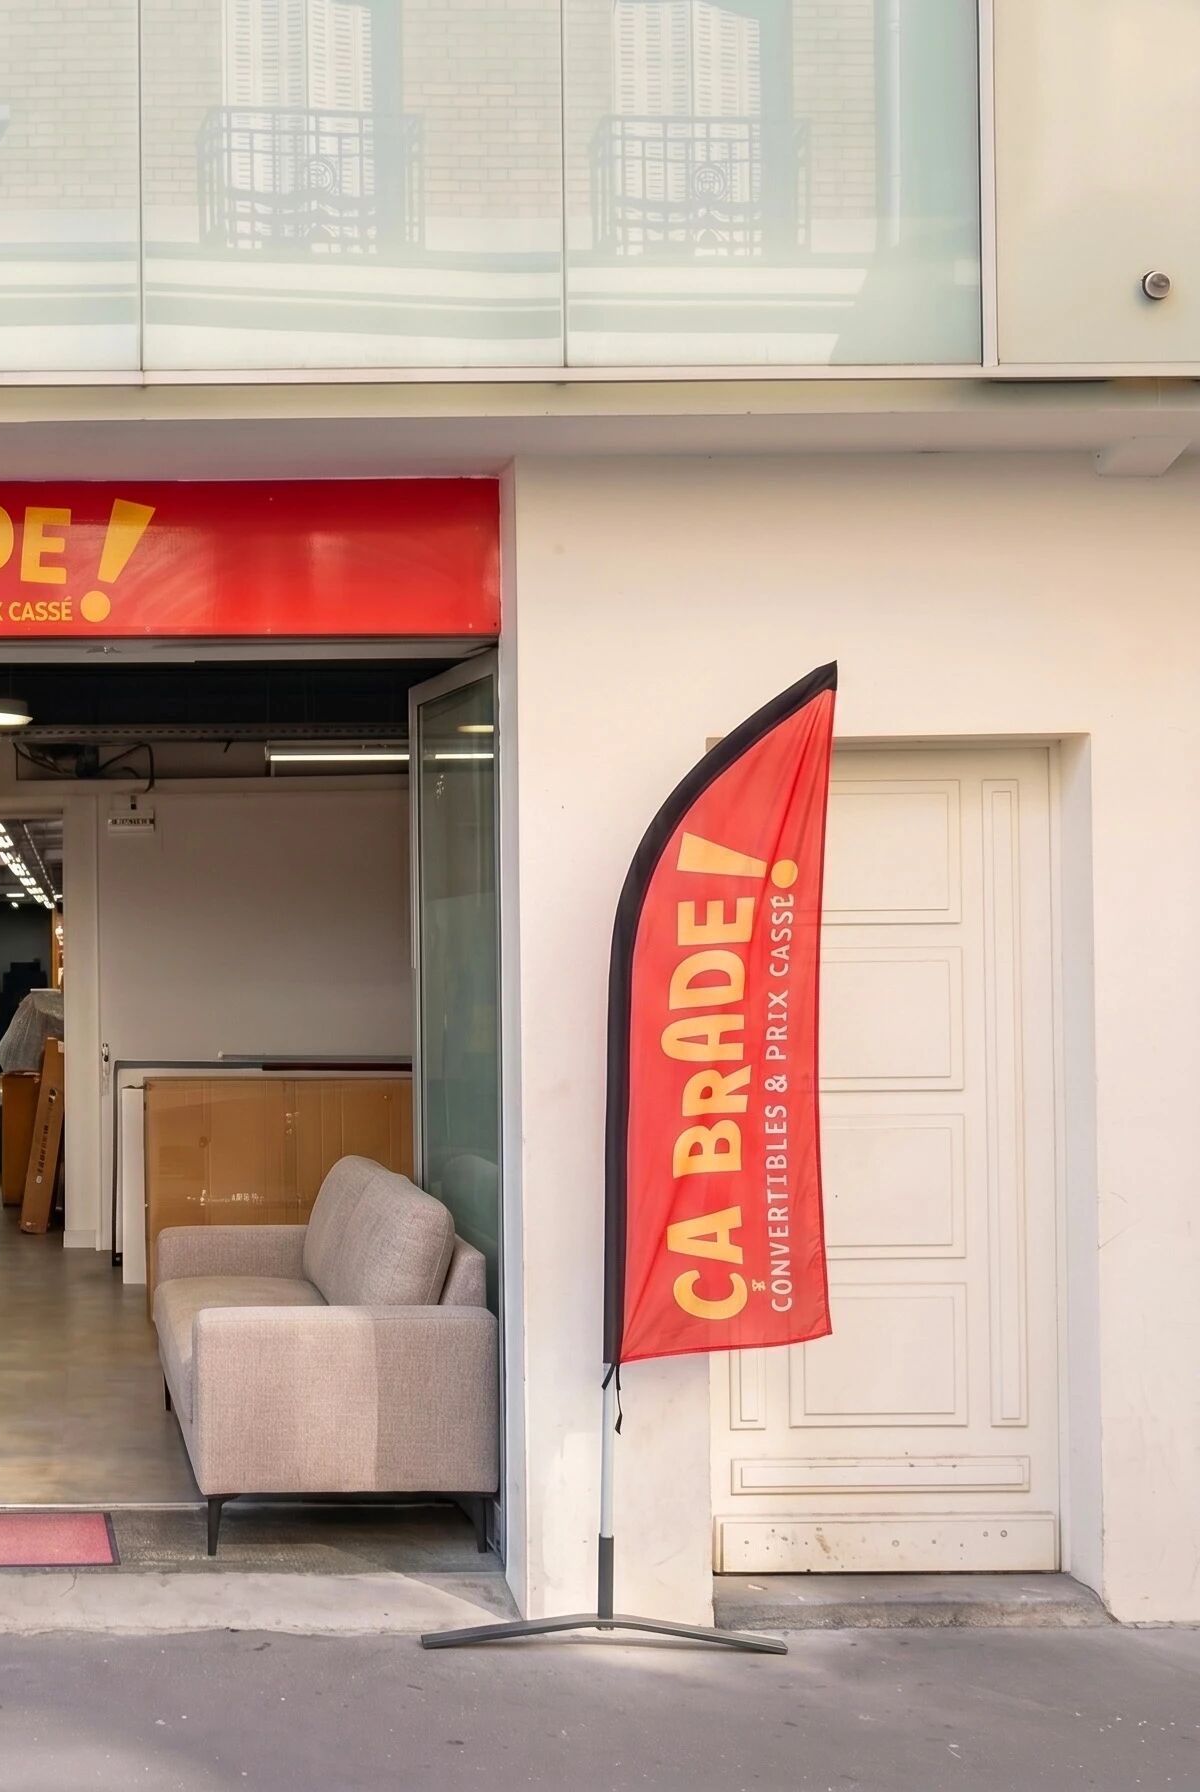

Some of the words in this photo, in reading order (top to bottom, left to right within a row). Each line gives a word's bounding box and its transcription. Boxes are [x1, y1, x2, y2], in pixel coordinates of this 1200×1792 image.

[7, 596, 73, 622] CASSÉ
[765, 989, 790, 1061] PRIX
[764, 1074, 788, 1093] &
[764, 1103, 793, 1313] CONVERTIBLES
